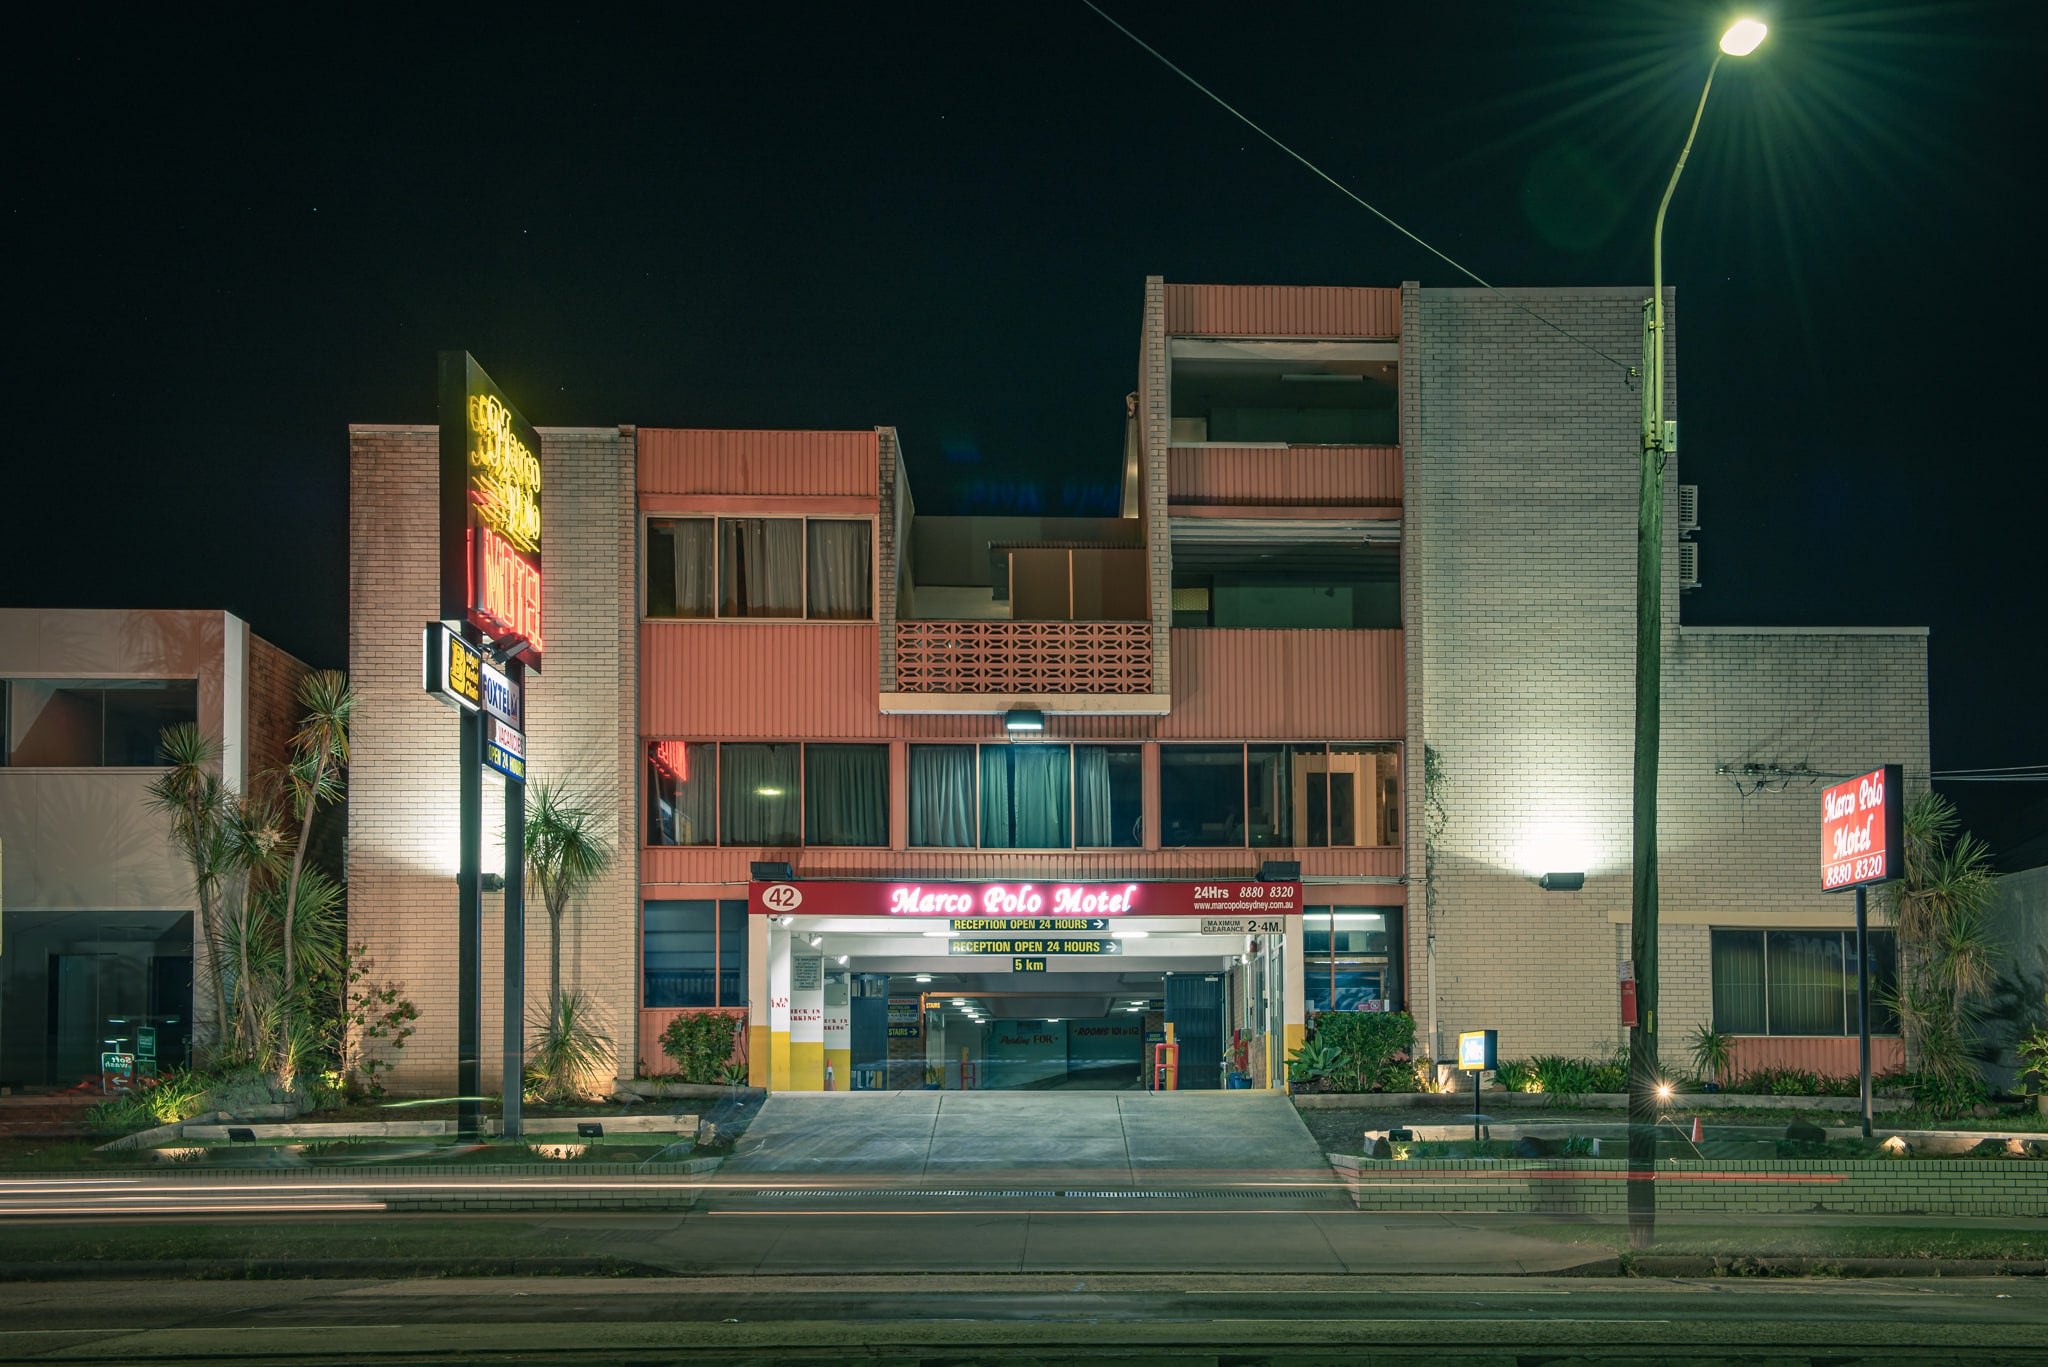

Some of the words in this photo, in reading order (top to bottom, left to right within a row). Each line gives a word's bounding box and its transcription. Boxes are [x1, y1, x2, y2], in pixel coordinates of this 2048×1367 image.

[484, 528, 543, 652] MOTEL
[482, 672, 511, 717] FOXTEL
[497, 723, 524, 756] VACANCIES
[488, 744, 502, 767] OPEN
[502, 751, 509, 770] 24
[509, 755, 525, 779] HOURS
[1824, 789, 1856, 823] Marco
[1859, 771, 1883, 811] Polo
[1833, 813, 1874, 860] Motel
[1826, 862, 1852, 887] 8880
[1854, 855, 1882, 880] 8320
[769, 888, 794, 906] 42
[890, 886, 973, 914] Marco
[983, 884, 1042, 913] Polo
[1053, 884, 1137, 913] Motel
[1194, 886, 1229, 899] 24Hrs
[1239, 886, 1264, 898] 8880
[1269, 886, 1294, 898] 8320
[1194, 900, 1294, 911] www.marcopolosydney.com.au
[954, 919, 1006, 930] RECEPTION
[1010, 919, 1035, 930] OPEN
[1039, 919, 1051, 930] 24
[1055, 919, 1087, 930] HOURS
[952, 941, 1010, 953] RECEPTION
[1014, 941, 1043, 953] OPEN
[1046, 941, 1060, 953] 24
[1064, 941, 1100, 953] HOURS
[1015, 959, 1023, 971] 5
[1026, 959, 1044, 971] km
[888, 1028, 908, 1036] STAIRS
[1033, 1035, 1053, 1044] FOR
[1078, 1027, 1109, 1036] ROOMS
